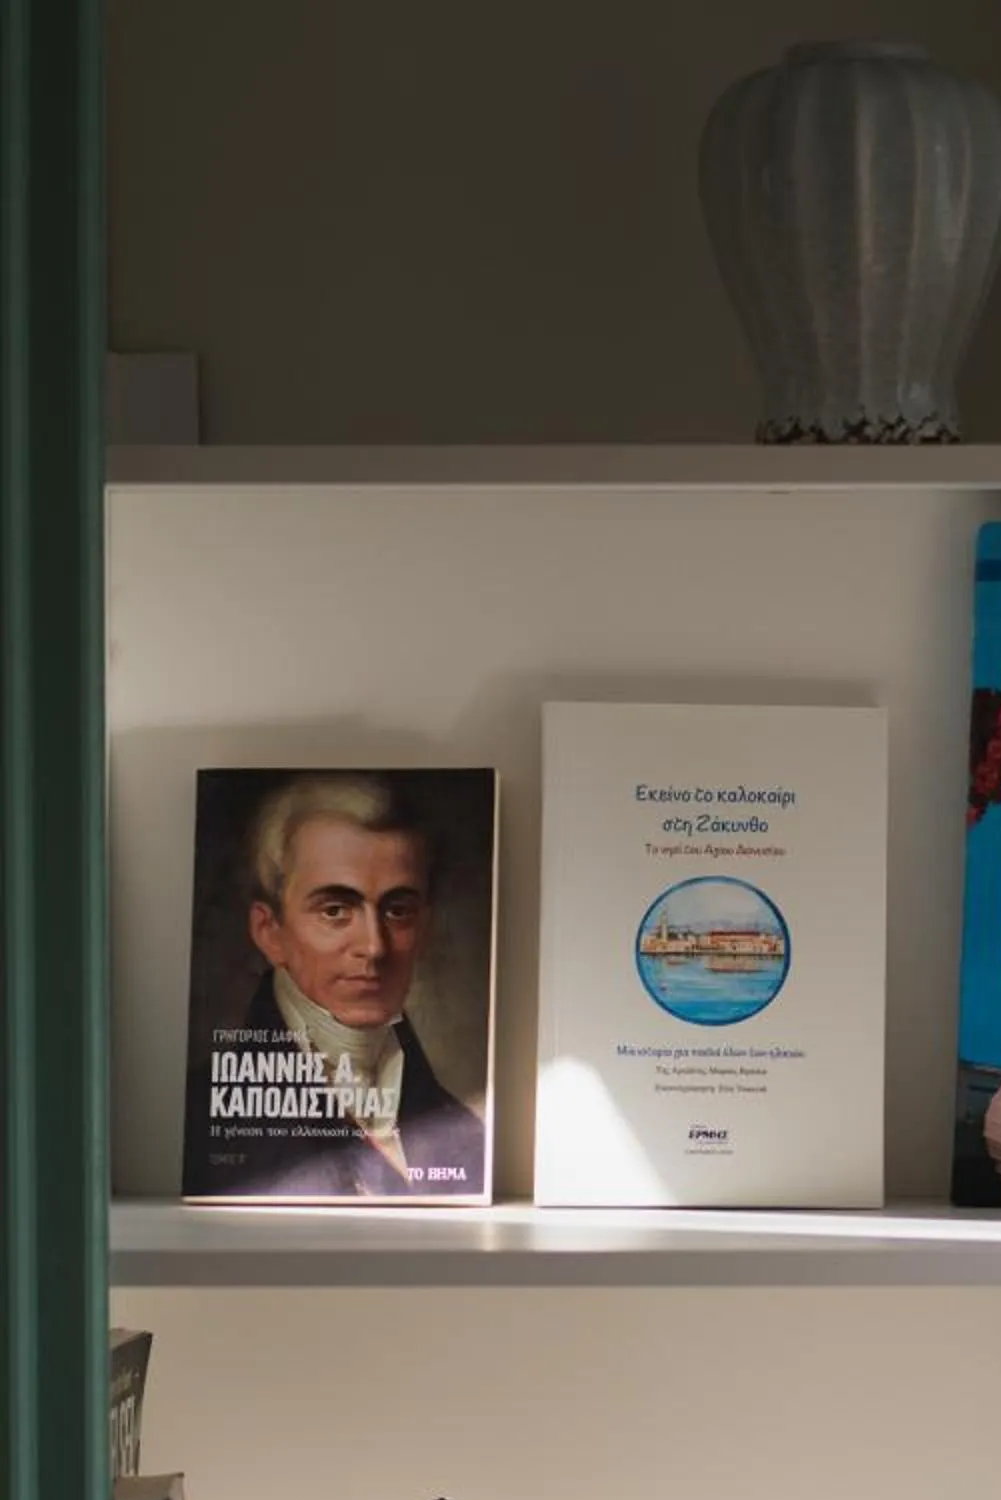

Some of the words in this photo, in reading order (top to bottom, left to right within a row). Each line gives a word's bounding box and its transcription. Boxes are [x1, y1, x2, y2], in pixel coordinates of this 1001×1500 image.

[717, 785, 795, 809] καλοκαίρι
[211, 1051, 328, 1083] ΙΩΑΝΝΗΣ
[209, 1086, 397, 1118] ΚΑΠΟΔΙΣΤΡΙΑΣ
